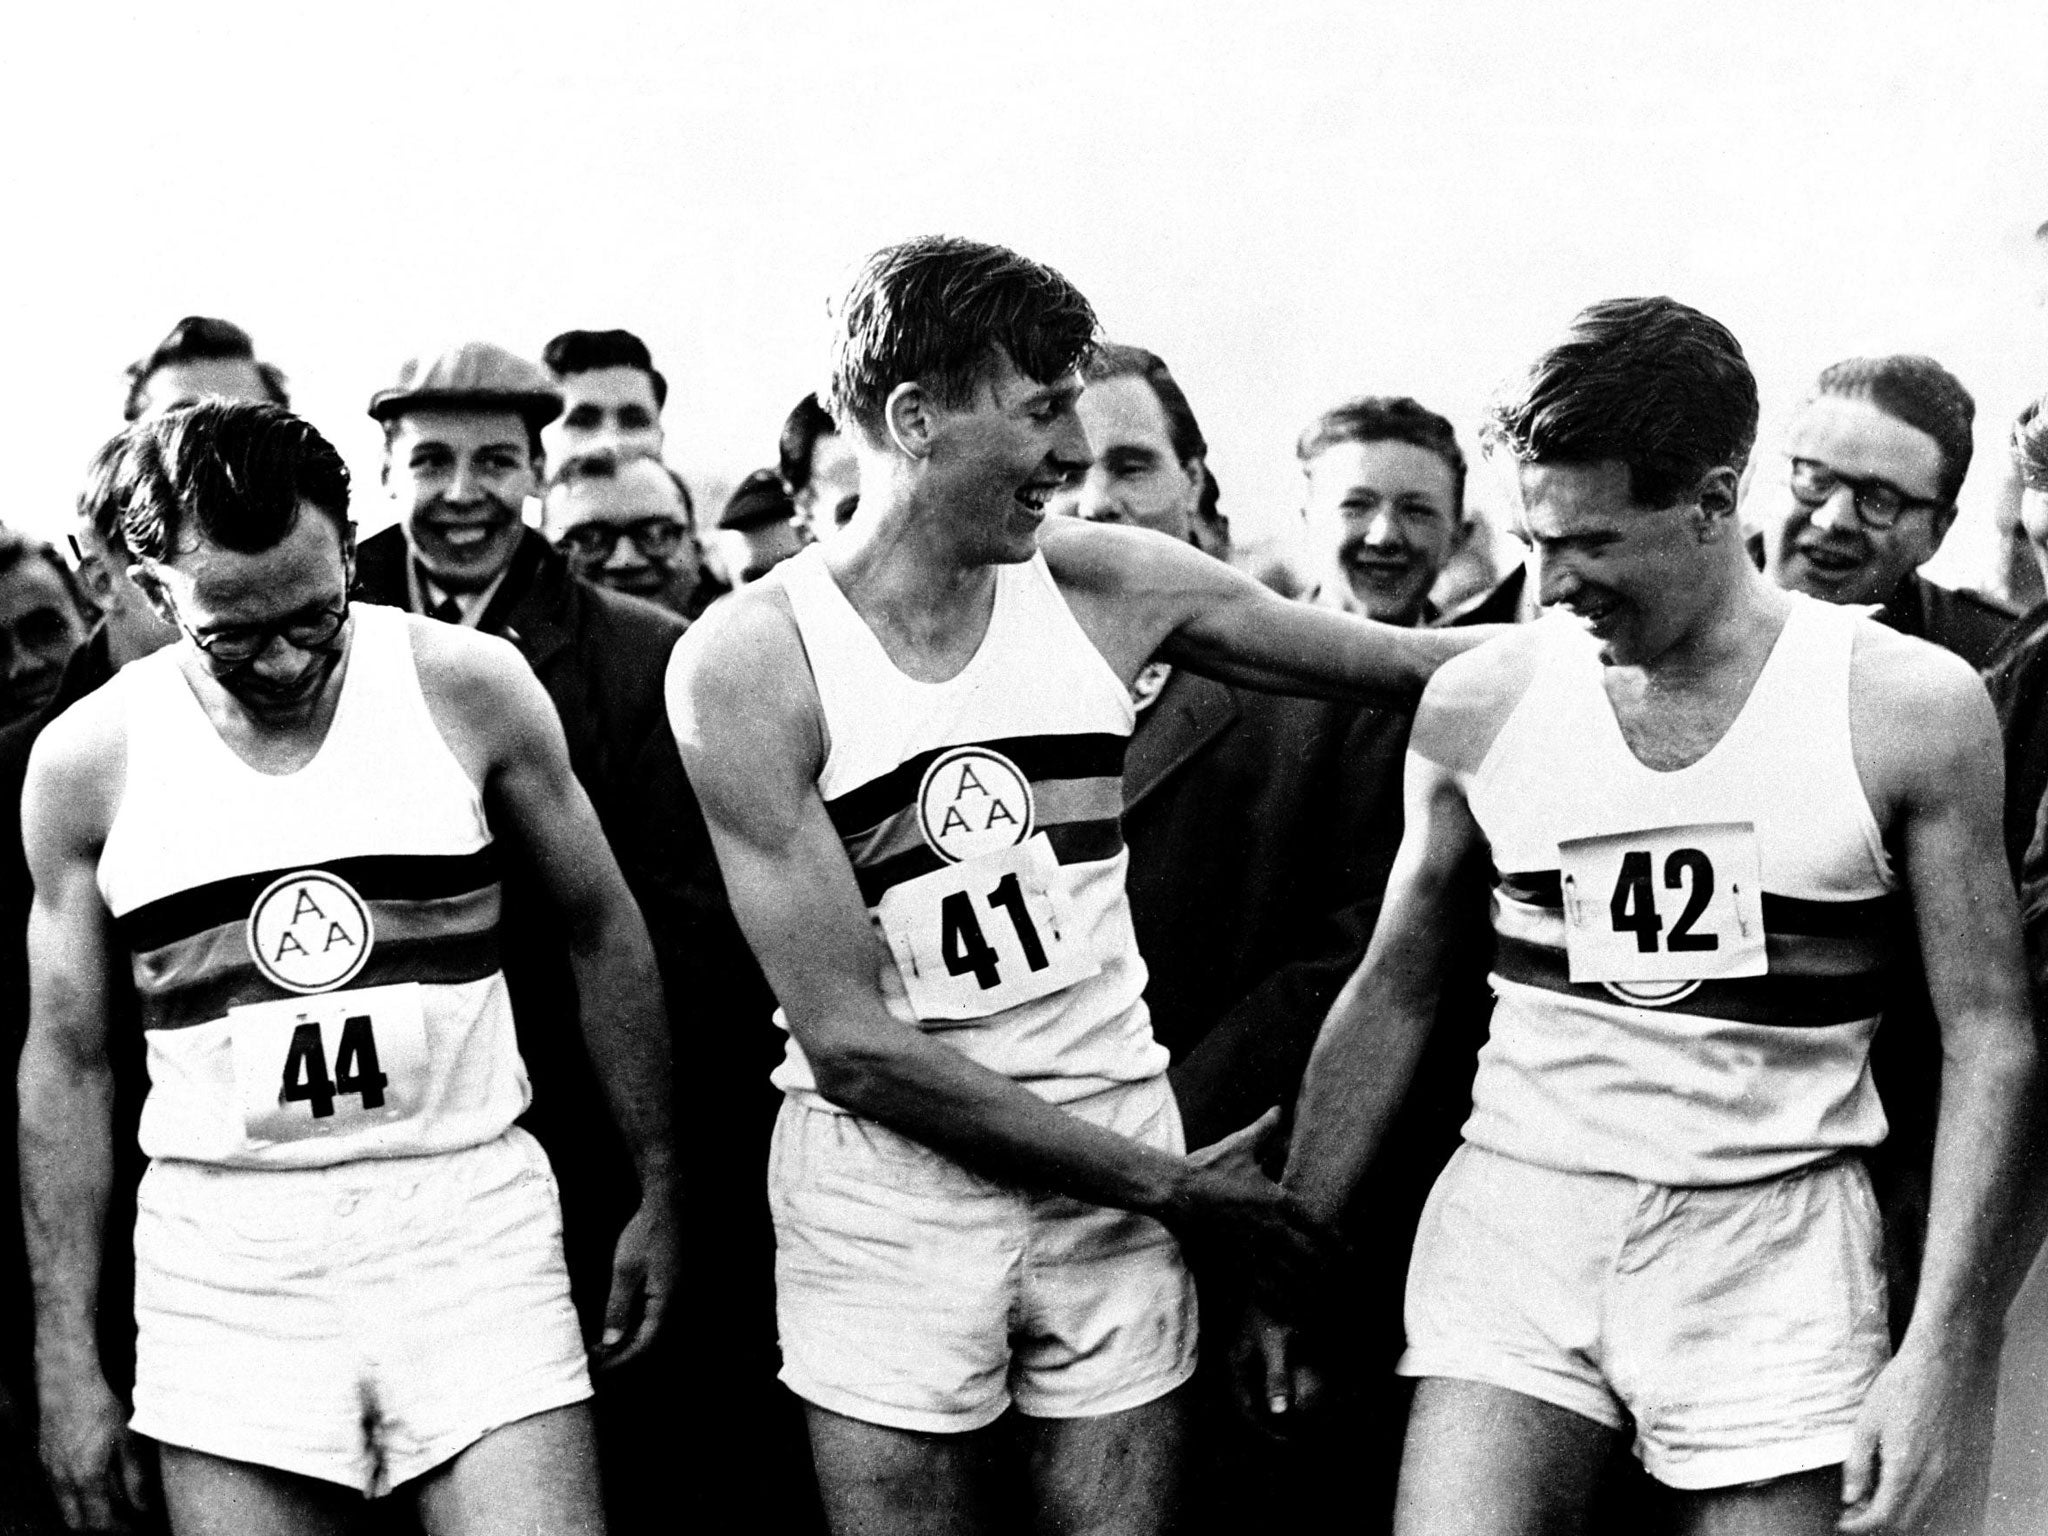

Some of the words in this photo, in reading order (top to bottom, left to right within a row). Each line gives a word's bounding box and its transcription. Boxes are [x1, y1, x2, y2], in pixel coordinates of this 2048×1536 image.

[942, 872, 1050, 990] 41
[1610, 848, 1718, 953] 42
[280, 1015, 388, 1118] 44
